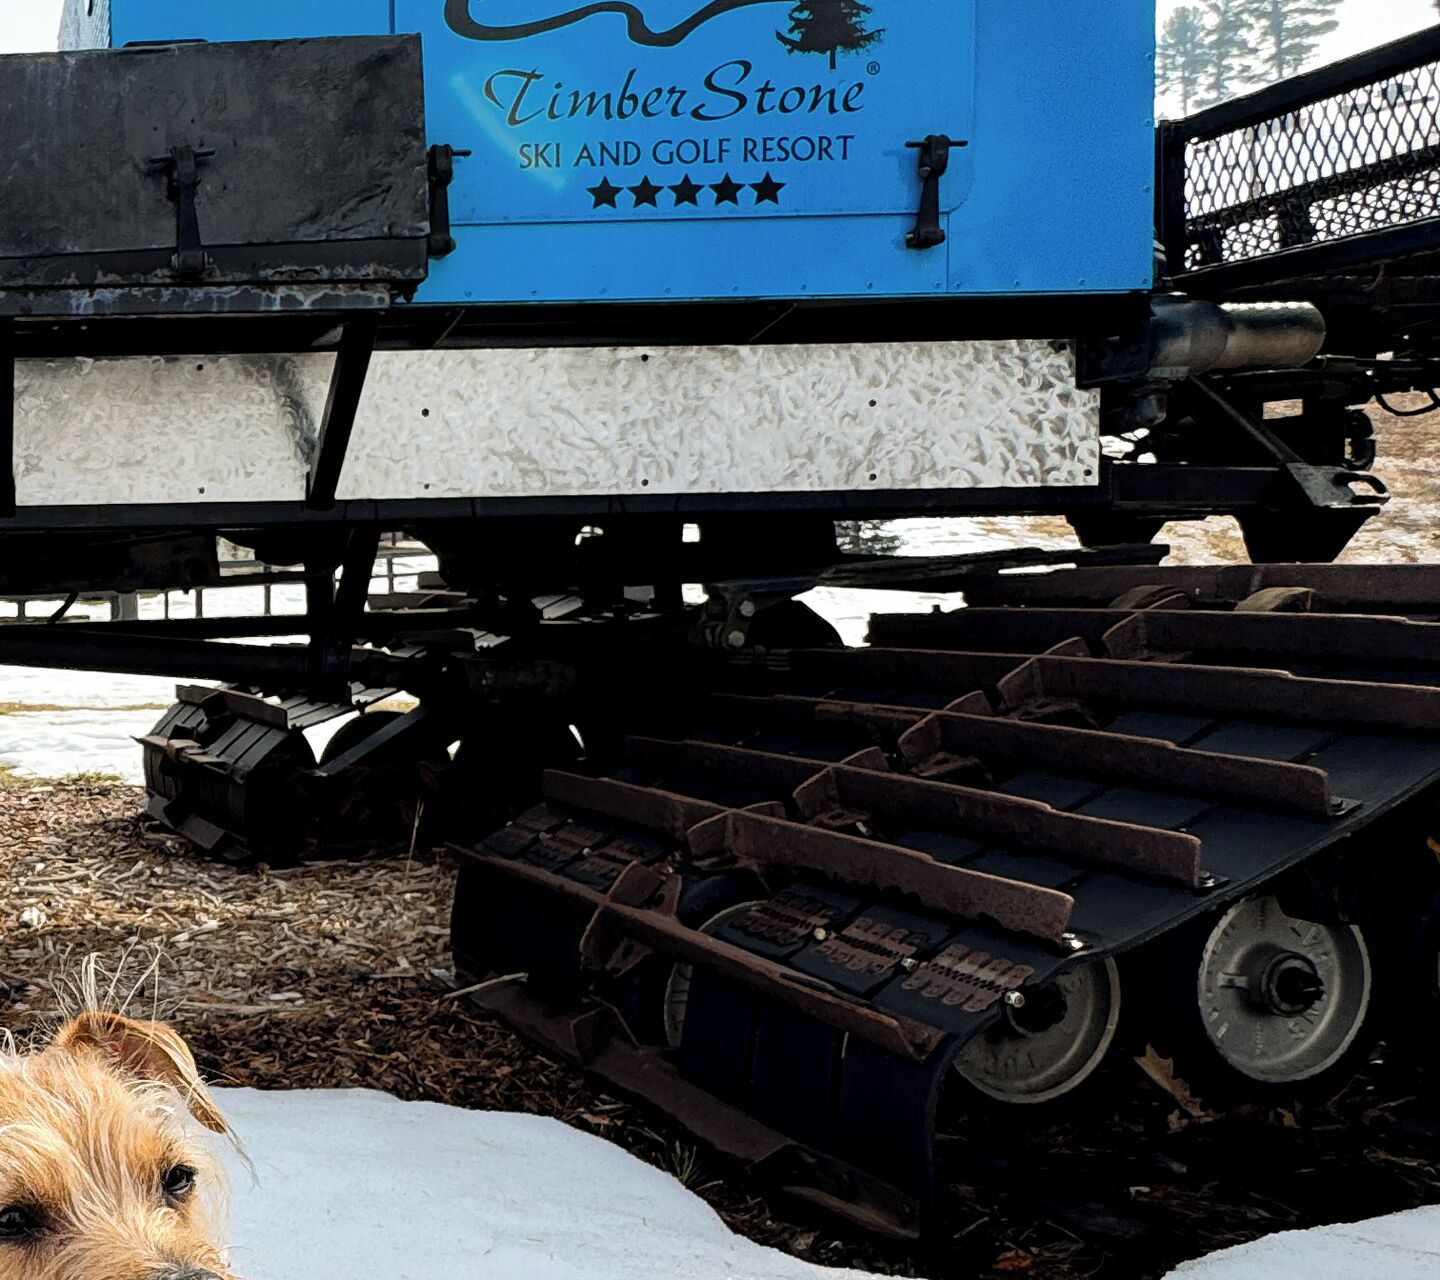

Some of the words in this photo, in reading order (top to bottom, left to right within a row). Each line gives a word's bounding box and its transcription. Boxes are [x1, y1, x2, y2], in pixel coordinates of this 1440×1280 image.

[519, 142, 562, 169] SKI
[573, 139, 641, 167] AND
[652, 137, 731, 165] GOLF
[742, 134, 855, 163] RESORT
